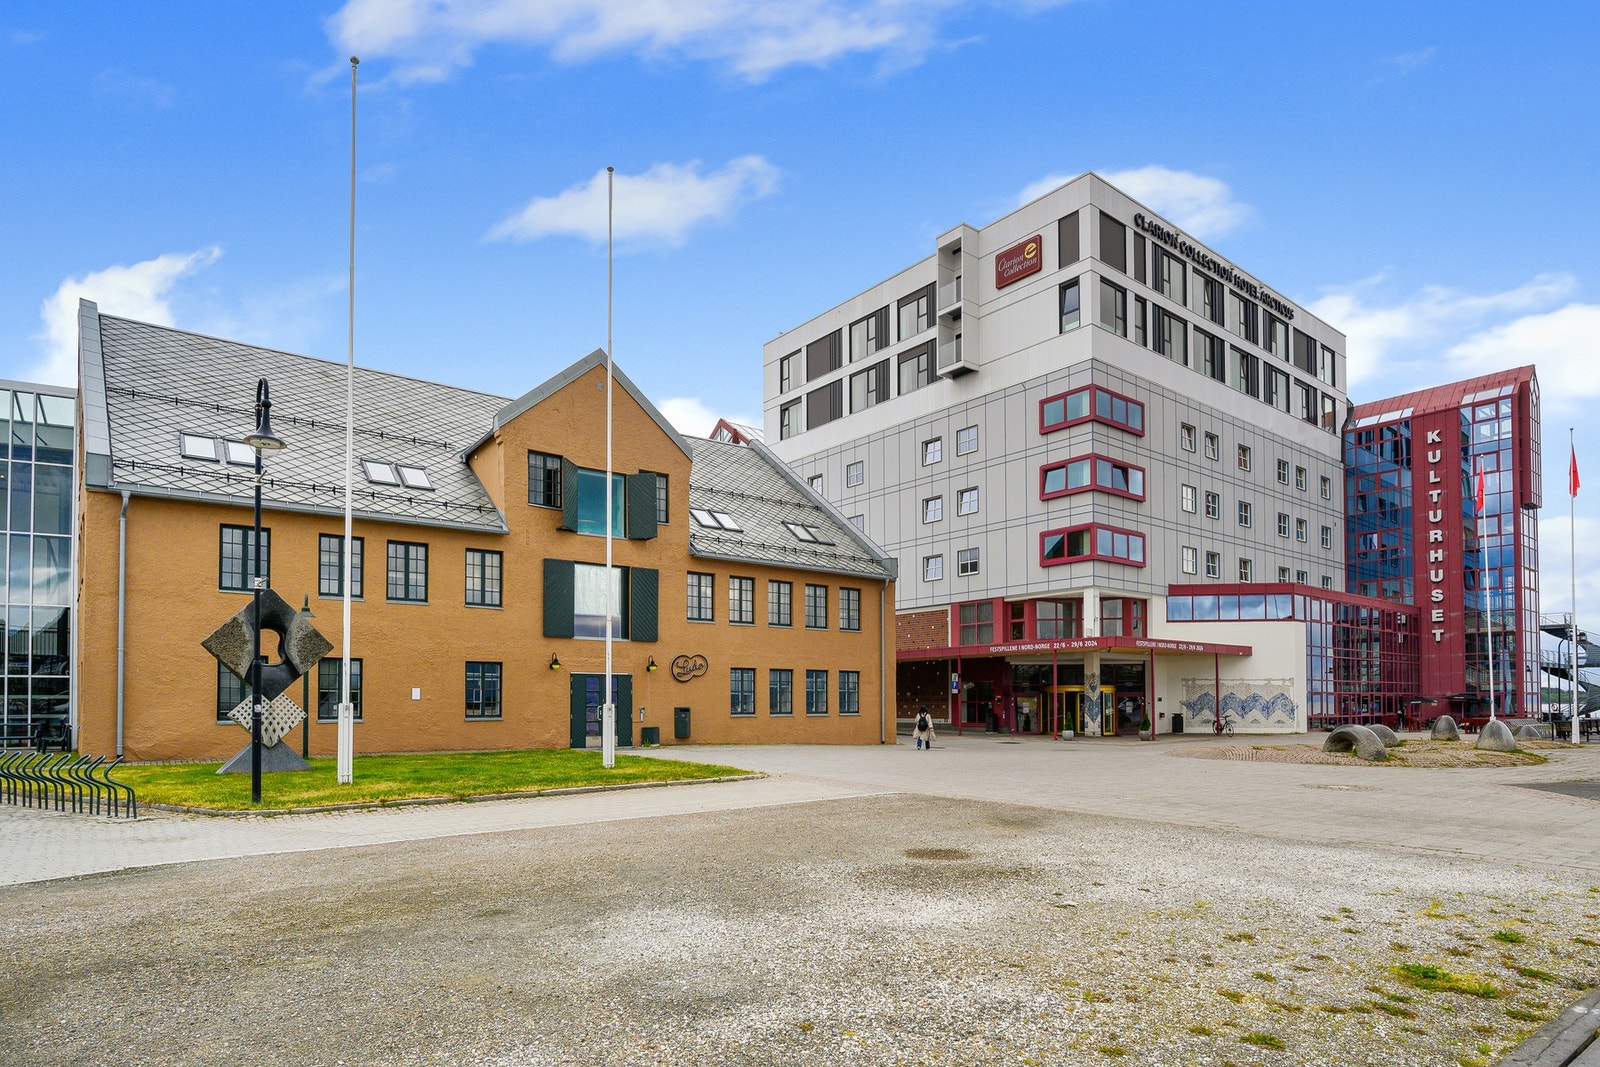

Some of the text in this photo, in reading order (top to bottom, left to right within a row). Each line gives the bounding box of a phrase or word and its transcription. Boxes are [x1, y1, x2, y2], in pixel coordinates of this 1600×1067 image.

[998, 254, 1025, 272] Clarion
[1003, 257, 1038, 278] Collection
[1133, 212, 1295, 320] CLARION COLLECTION HOTEL ARCTICUS
[1427, 430, 1444, 642] KULTURHUSET
[989, 645, 1018, 653] FESTSPILLENE
[1021, 643, 1050, 651] NORD-NORGE
[1053, 641, 1066, 649] 22/6
[1071, 640, 1084, 648] 29/6
